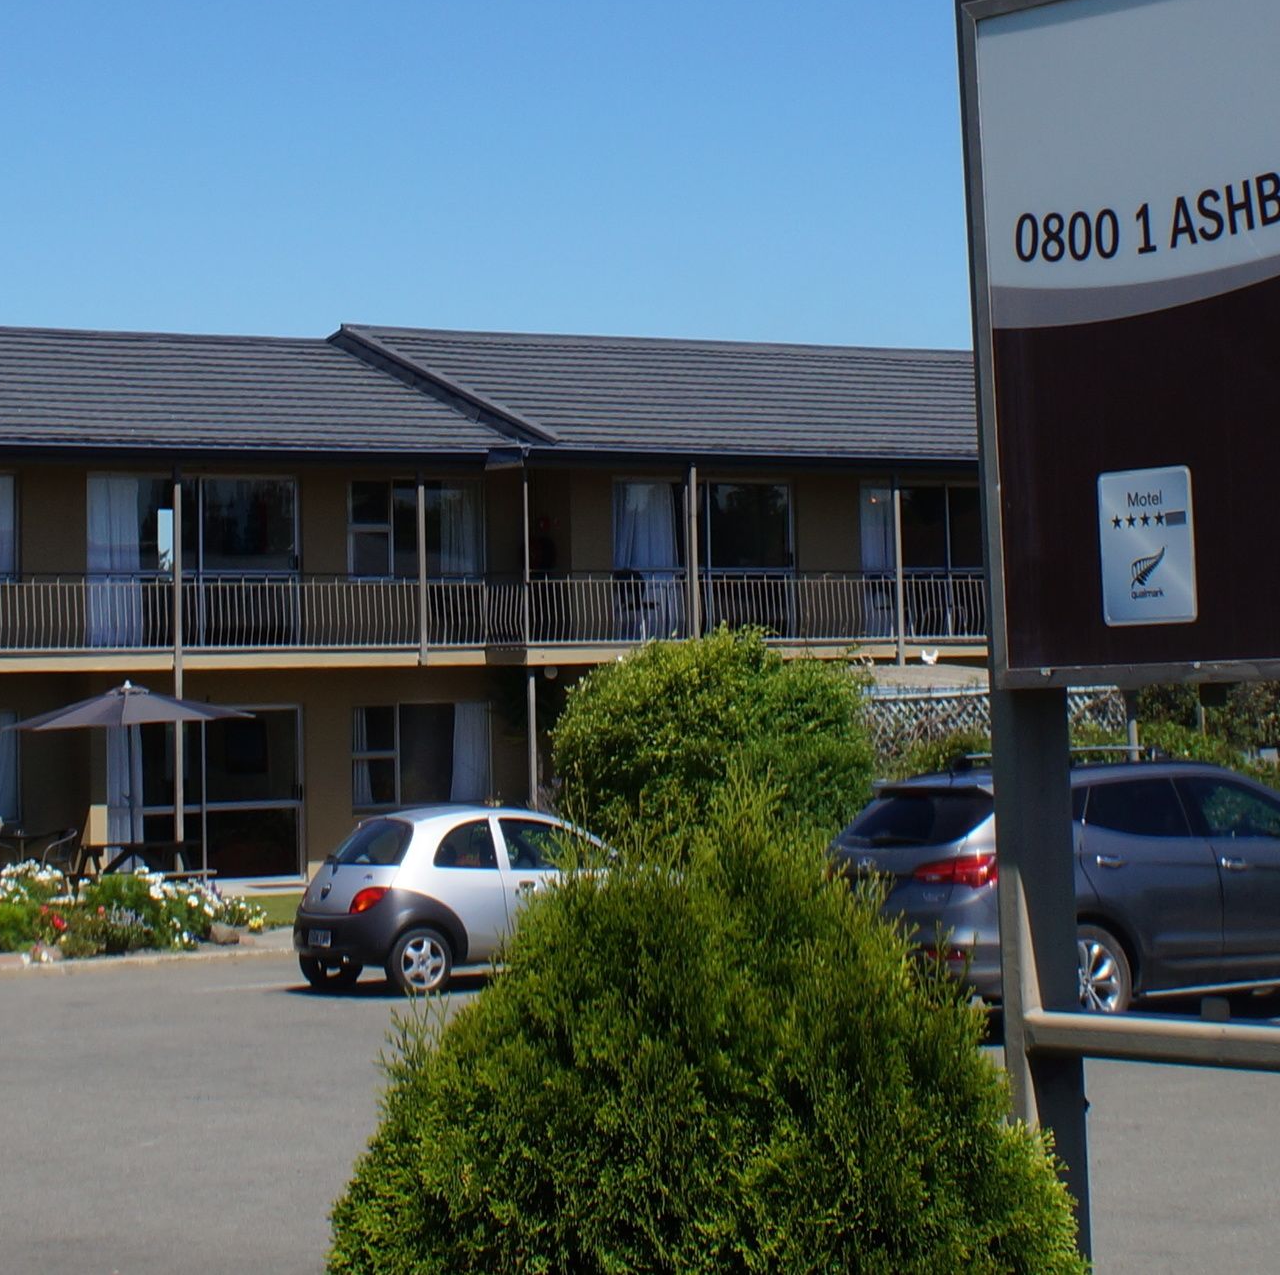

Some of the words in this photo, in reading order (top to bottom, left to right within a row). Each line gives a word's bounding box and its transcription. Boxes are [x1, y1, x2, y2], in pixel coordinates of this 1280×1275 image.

[1015, 208, 1120, 263] 0800
[1134, 202, 1157, 255] 1
[1127, 489, 1163, 507] Motel
